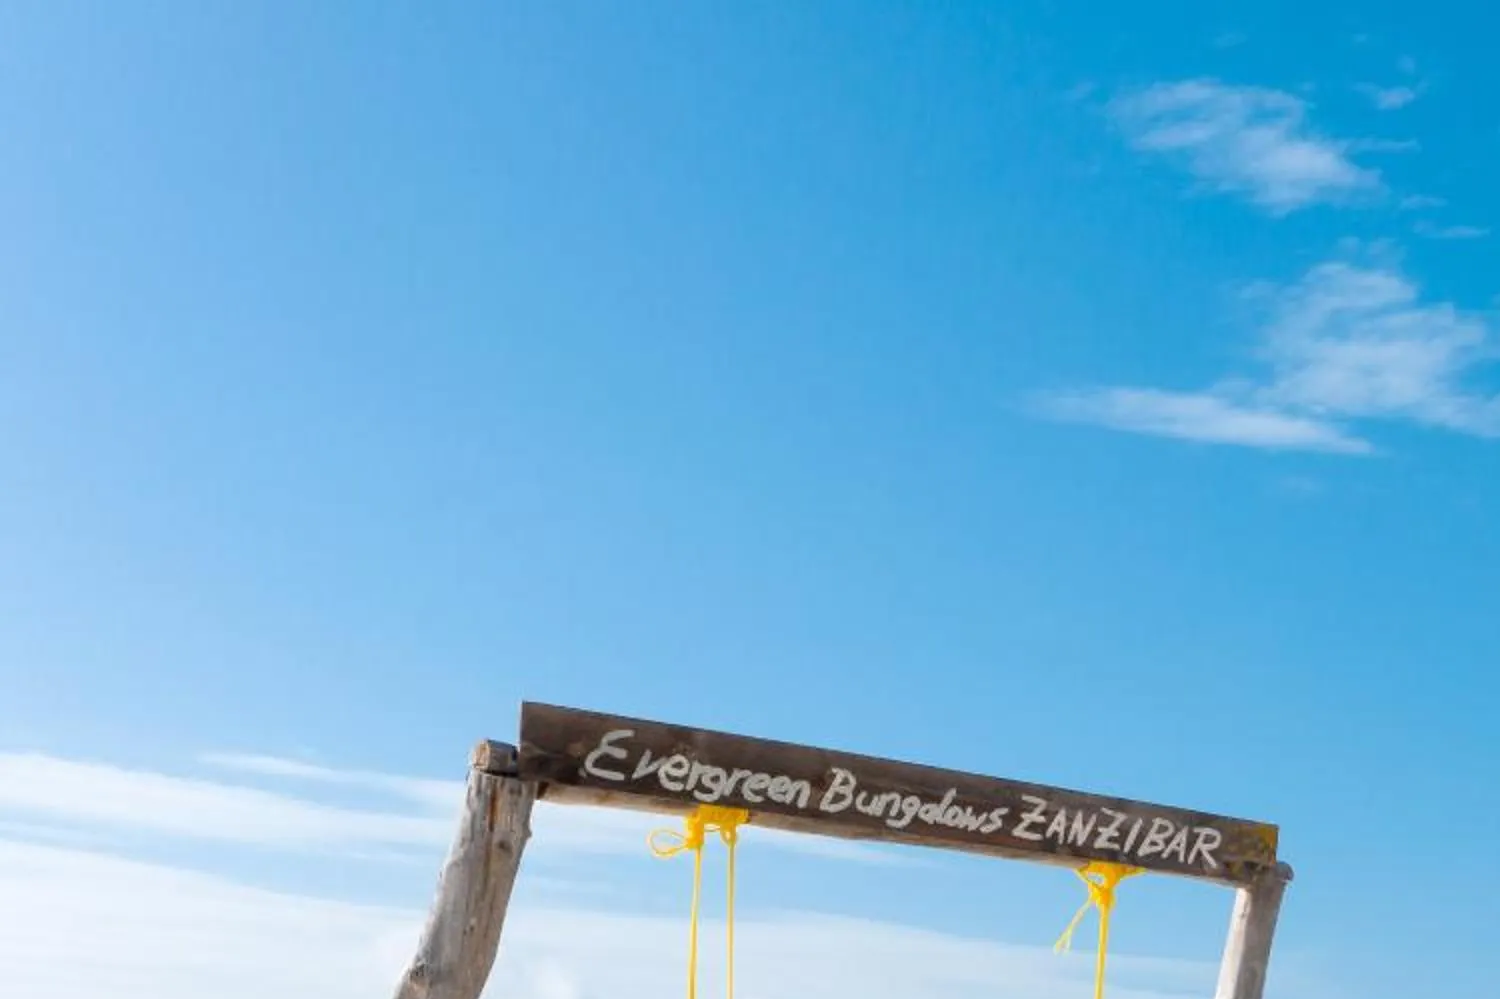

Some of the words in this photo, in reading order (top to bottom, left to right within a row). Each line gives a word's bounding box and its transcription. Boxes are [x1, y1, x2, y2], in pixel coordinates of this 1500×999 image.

[583, 729, 811, 807] Evergreen
[819, 766, 1009, 835] Bungalows
[1011, 794, 1223, 869] ZANZIBAR
